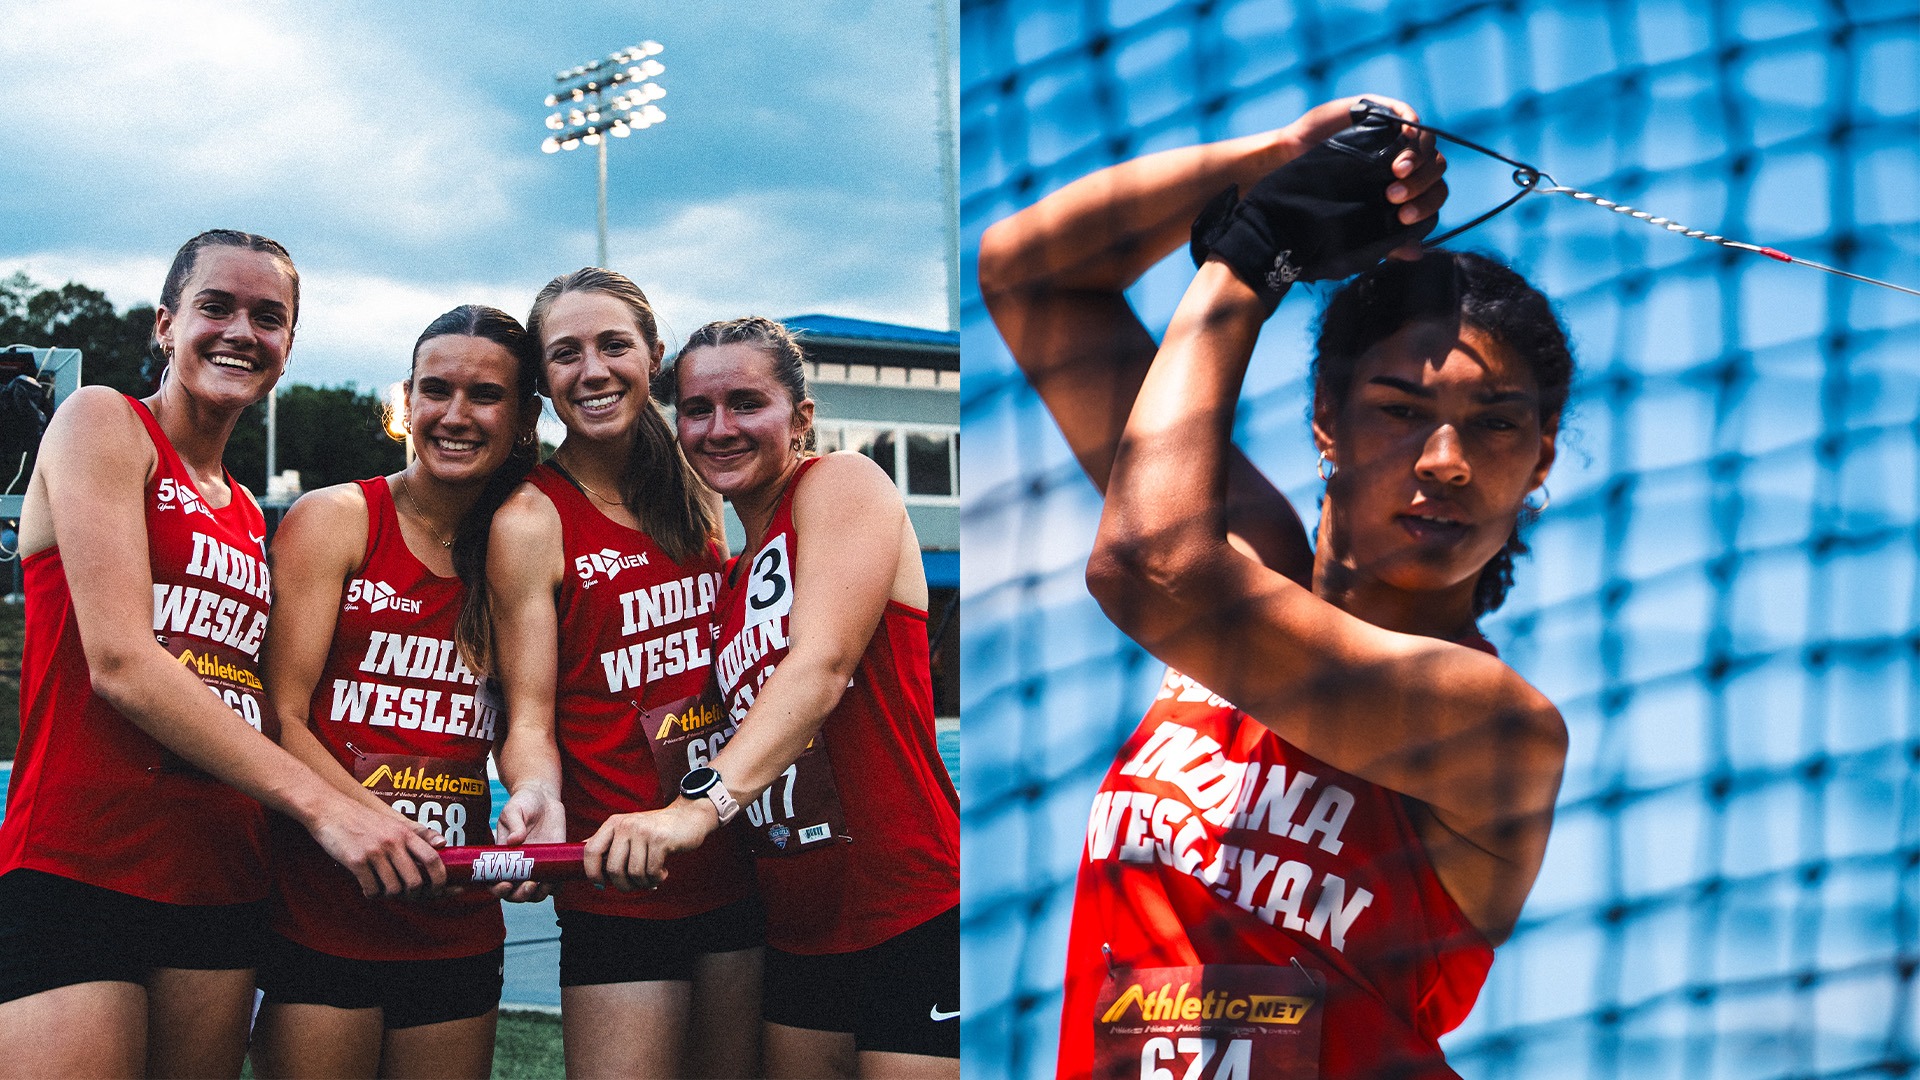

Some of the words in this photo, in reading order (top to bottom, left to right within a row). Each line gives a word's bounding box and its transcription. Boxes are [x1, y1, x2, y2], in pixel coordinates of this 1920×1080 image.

[186, 531, 271, 606] INDIA
[749, 547, 786, 610] 3
[152, 583, 268, 662] WESLE
[389, 596, 421, 614] UEN
[619, 572, 724, 636] INDIA
[358, 630, 482, 685] INDIA
[600, 624, 713, 694] WESL
[462, 782, 483, 793] NET
[1119, 720, 1356, 857] INDIANA
[472, 851, 535, 881] IWU
[1101, 982, 1250, 1023] Athletic
[1254, 1001, 1304, 1019] NET
